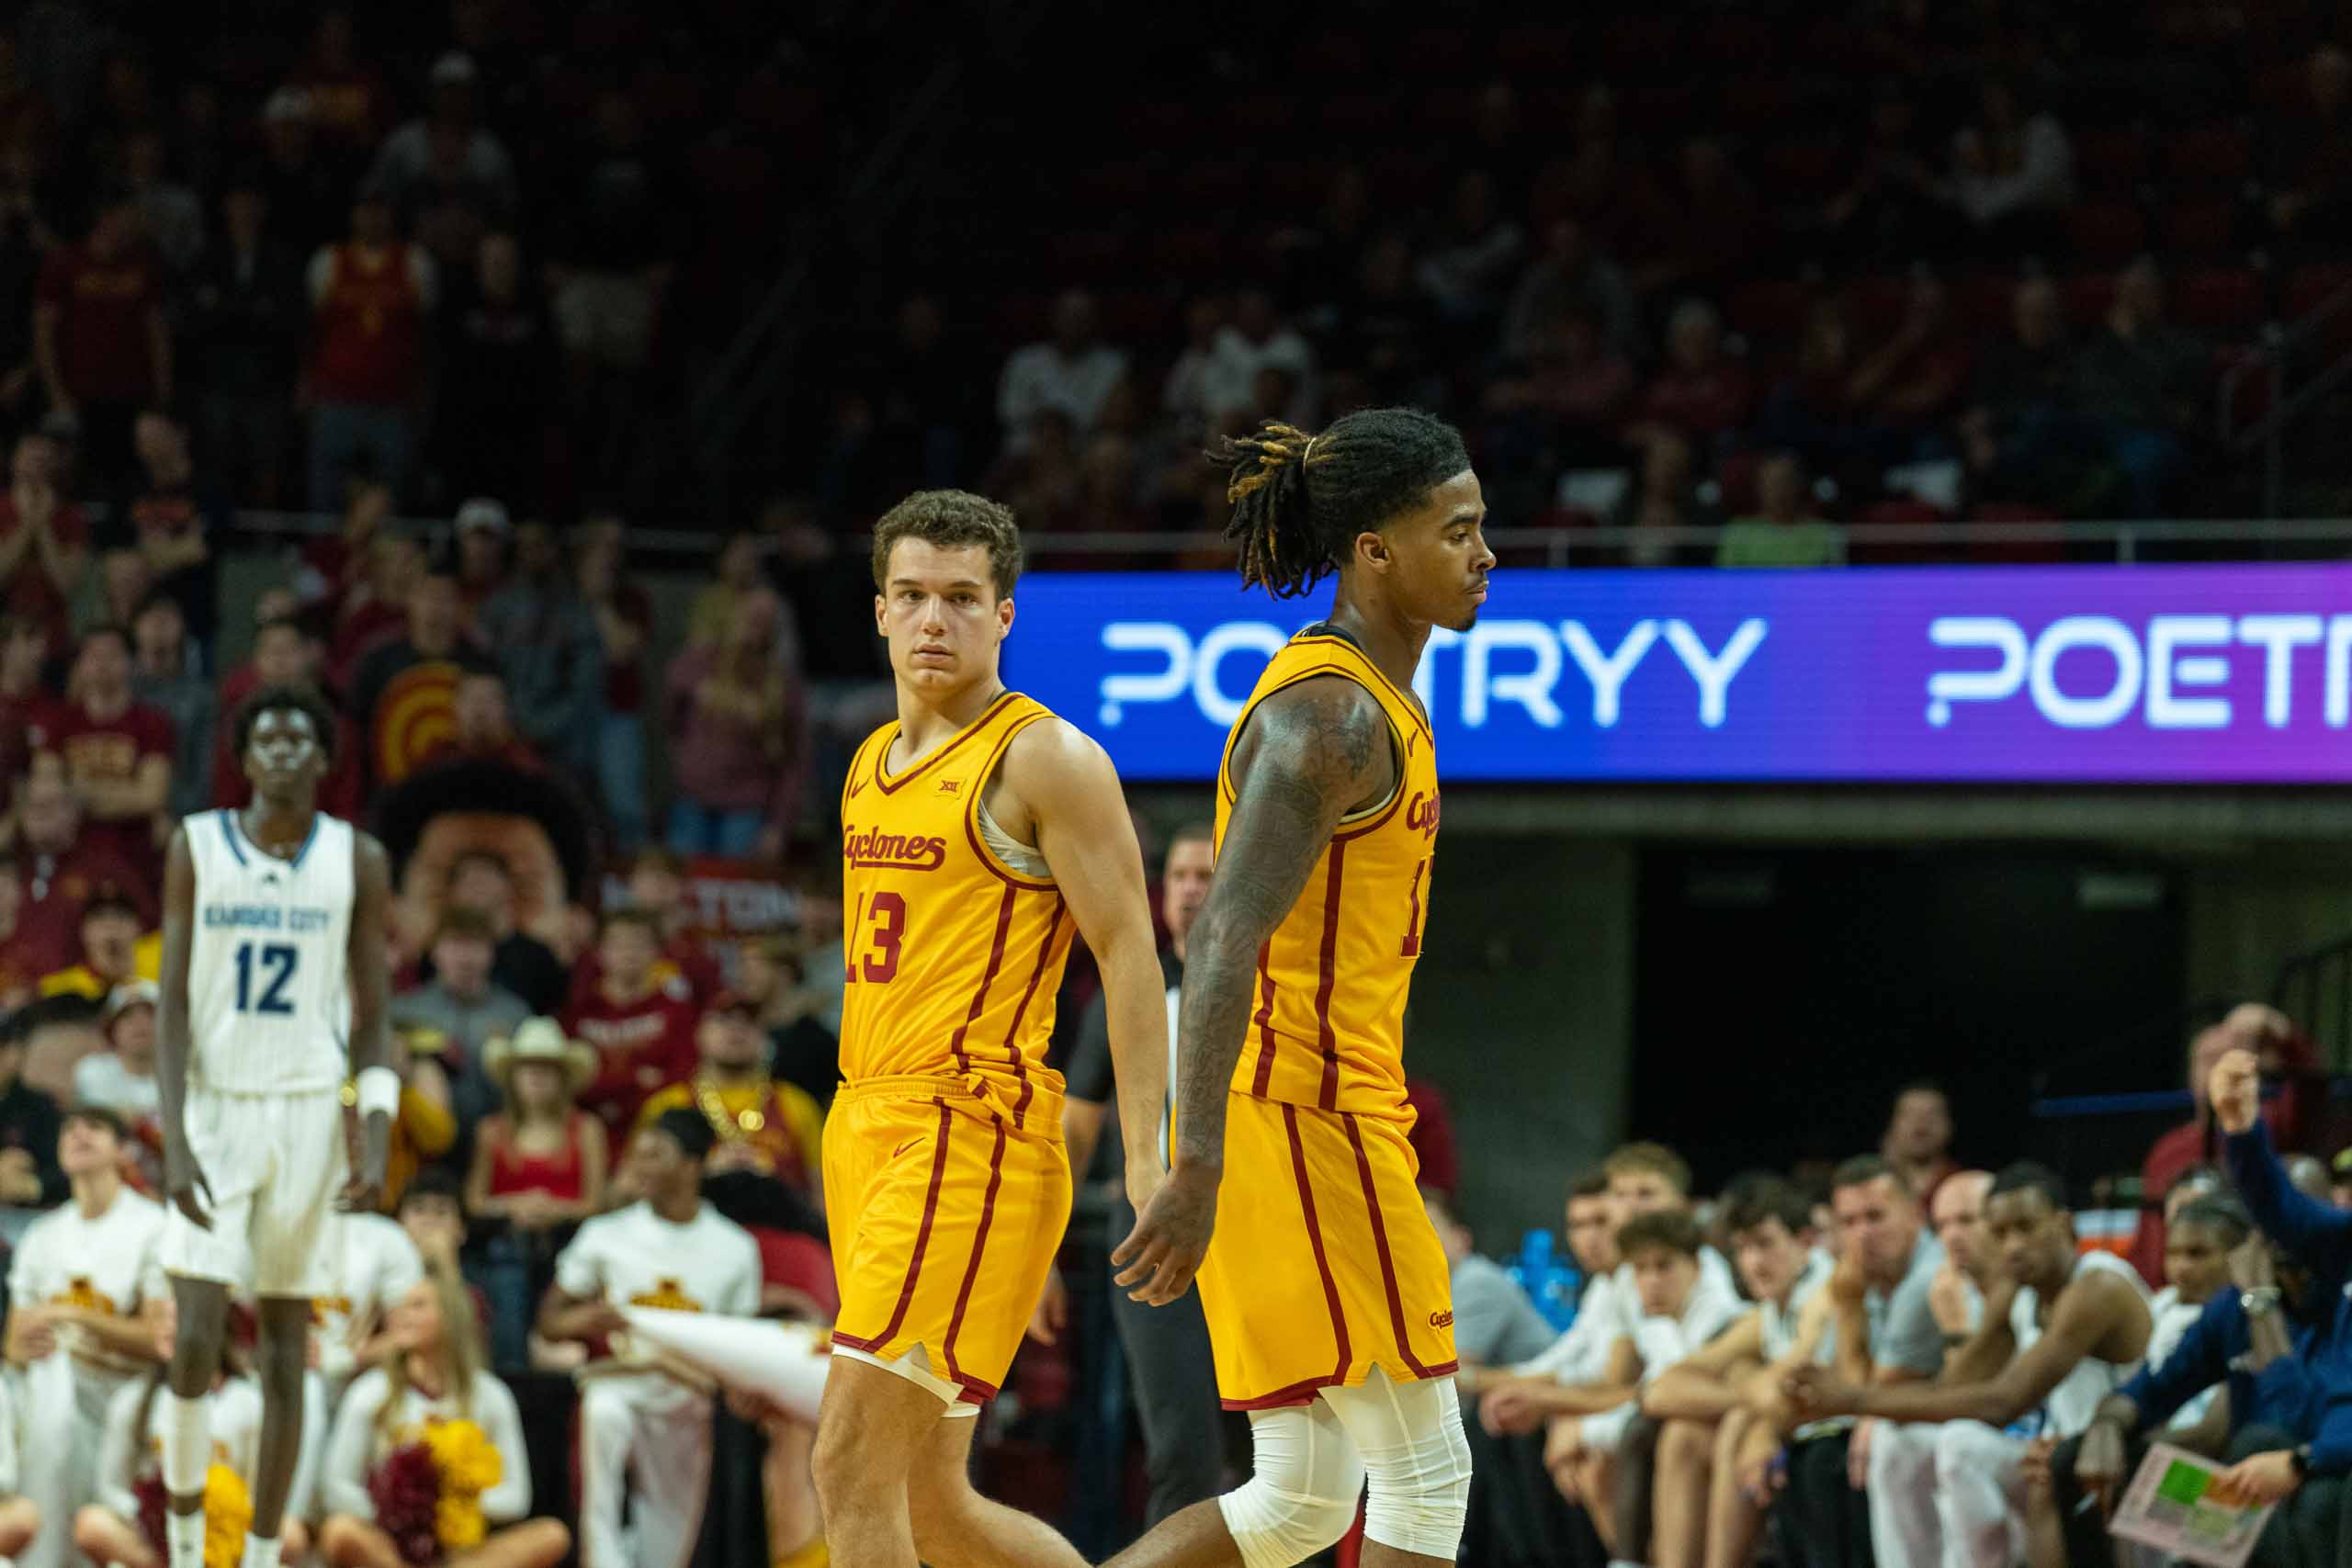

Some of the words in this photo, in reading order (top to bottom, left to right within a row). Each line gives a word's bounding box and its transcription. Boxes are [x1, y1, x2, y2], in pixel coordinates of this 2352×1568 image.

[1099, 618, 1768, 728] PORYY
[1926, 615, 2352, 728] POET
[235, 940, 298, 1013] 12
